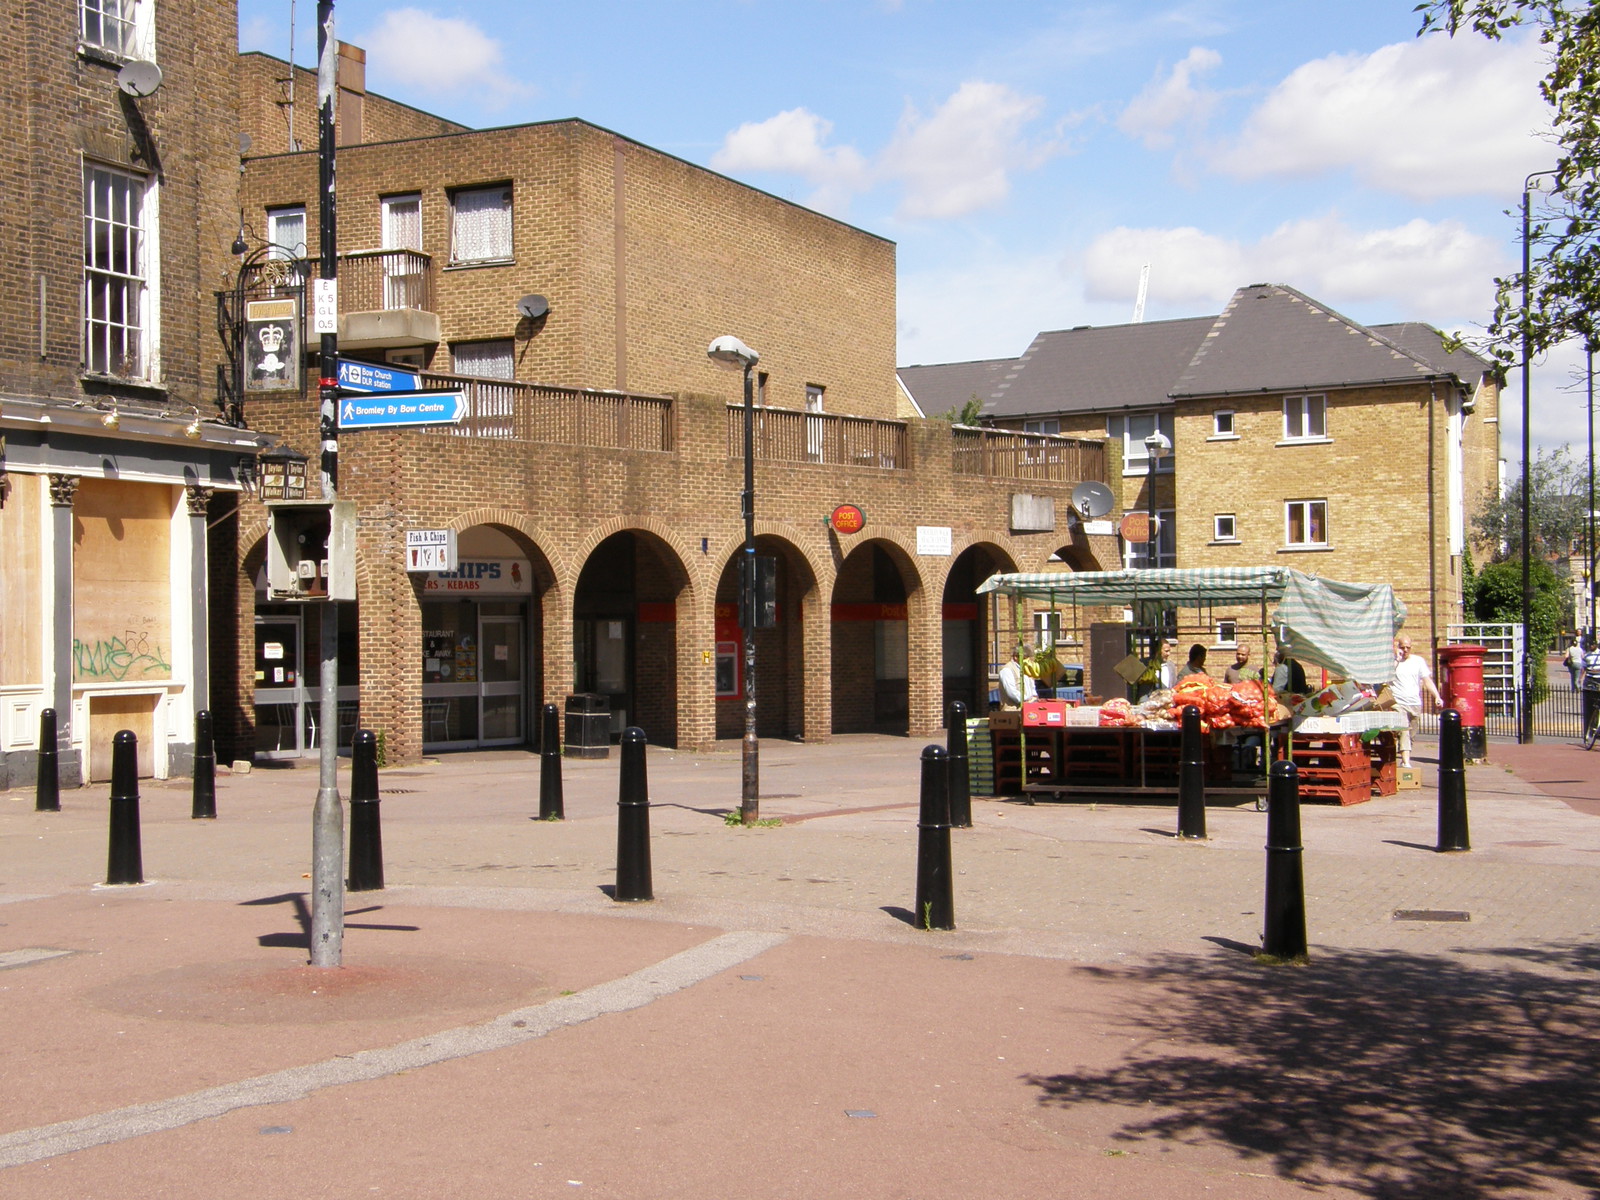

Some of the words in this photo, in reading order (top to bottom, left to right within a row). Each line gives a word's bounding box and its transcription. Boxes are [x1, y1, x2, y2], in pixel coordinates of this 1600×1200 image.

[361, 367, 374, 377] Bow
[374, 370, 393, 380] Church
[361, 377, 373, 386] DLR
[373, 380, 392, 389] station
[355, 406, 385, 416] Bromley
[387, 405, 398, 414] By
[400, 404, 417, 413] Bow
[418, 403, 445, 412] Centre
[838, 511, 856, 520] POST
[835, 519, 858, 528] OFFICE
[409, 532, 422, 542] Fish
[430, 531, 446, 543] Chips
[1124, 527, 1149, 537] Offic
[447, 580, 480, 590] KEBABS
